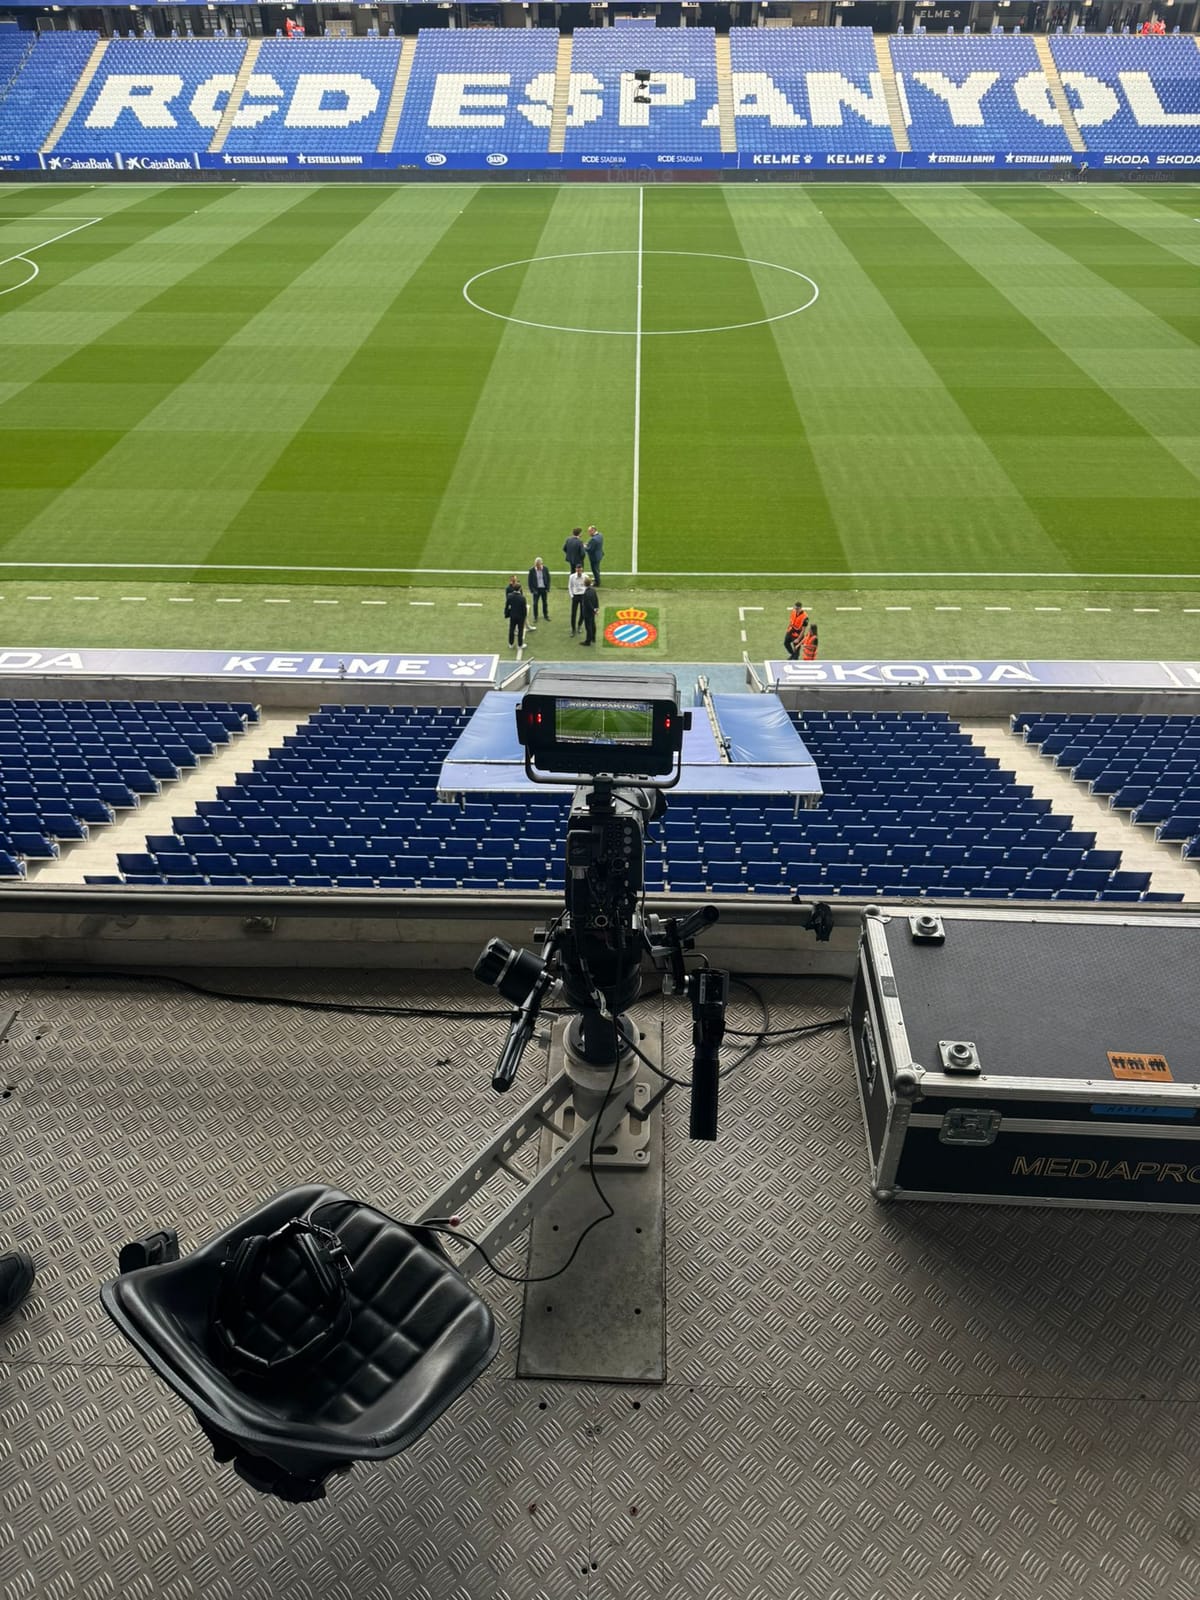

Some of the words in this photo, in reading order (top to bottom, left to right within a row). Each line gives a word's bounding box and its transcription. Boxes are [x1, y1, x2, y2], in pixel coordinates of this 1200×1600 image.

[84, 73, 381, 129] RCD
[427, 71, 1200, 129] ESPANYOL
[141, 157, 192, 169] CaixaBank
[233, 155, 266, 164] ESTRELLA
[267, 155, 289, 164] DAMM
[307, 155, 340, 164] ESTRELLA
[341, 155, 363, 164] DAMM
[581, 155, 599, 163] RCDE
[600, 155, 627, 163] STADIUM
[657, 155, 675, 163] RCDE
[676, 155, 702, 163] STADIUM
[753, 154, 801, 164] KELME
[826, 154, 874, 164] KELME
[938, 155, 972, 163] ESTRELLA
[973, 155, 995, 163] DAMM
[1015, 155, 1049, 163] ESTRELLA
[1050, 155, 1073, 163] DAMM
[1103, 155, 1150, 164] SKODA
[1156, 155, 1200, 164] SKODA
[222, 656, 430, 676] KELME
[783, 663, 1041, 682] SKODA
